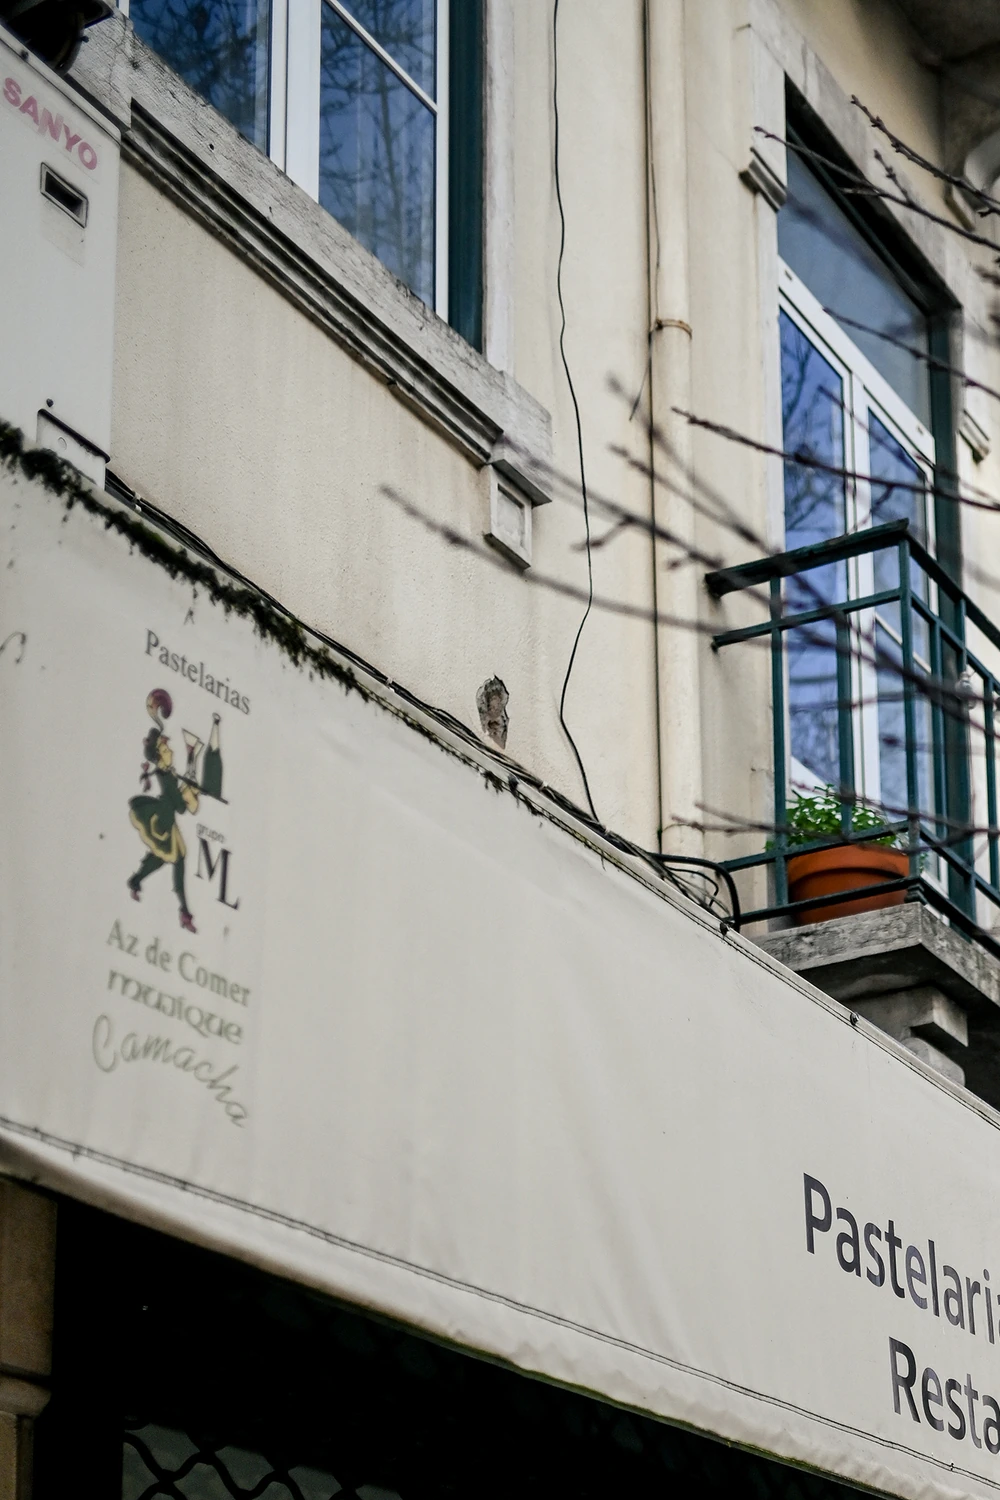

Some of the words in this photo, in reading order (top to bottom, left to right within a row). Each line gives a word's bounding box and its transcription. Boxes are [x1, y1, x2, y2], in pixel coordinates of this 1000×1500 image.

[2, 77, 98, 171] SANYO
[145, 628, 251, 715] Pastelarias
[194, 836, 240, 910] ML
[107, 919, 139, 957] Az
[145, 937, 173, 972] de
[178, 952, 251, 1007] Comer
